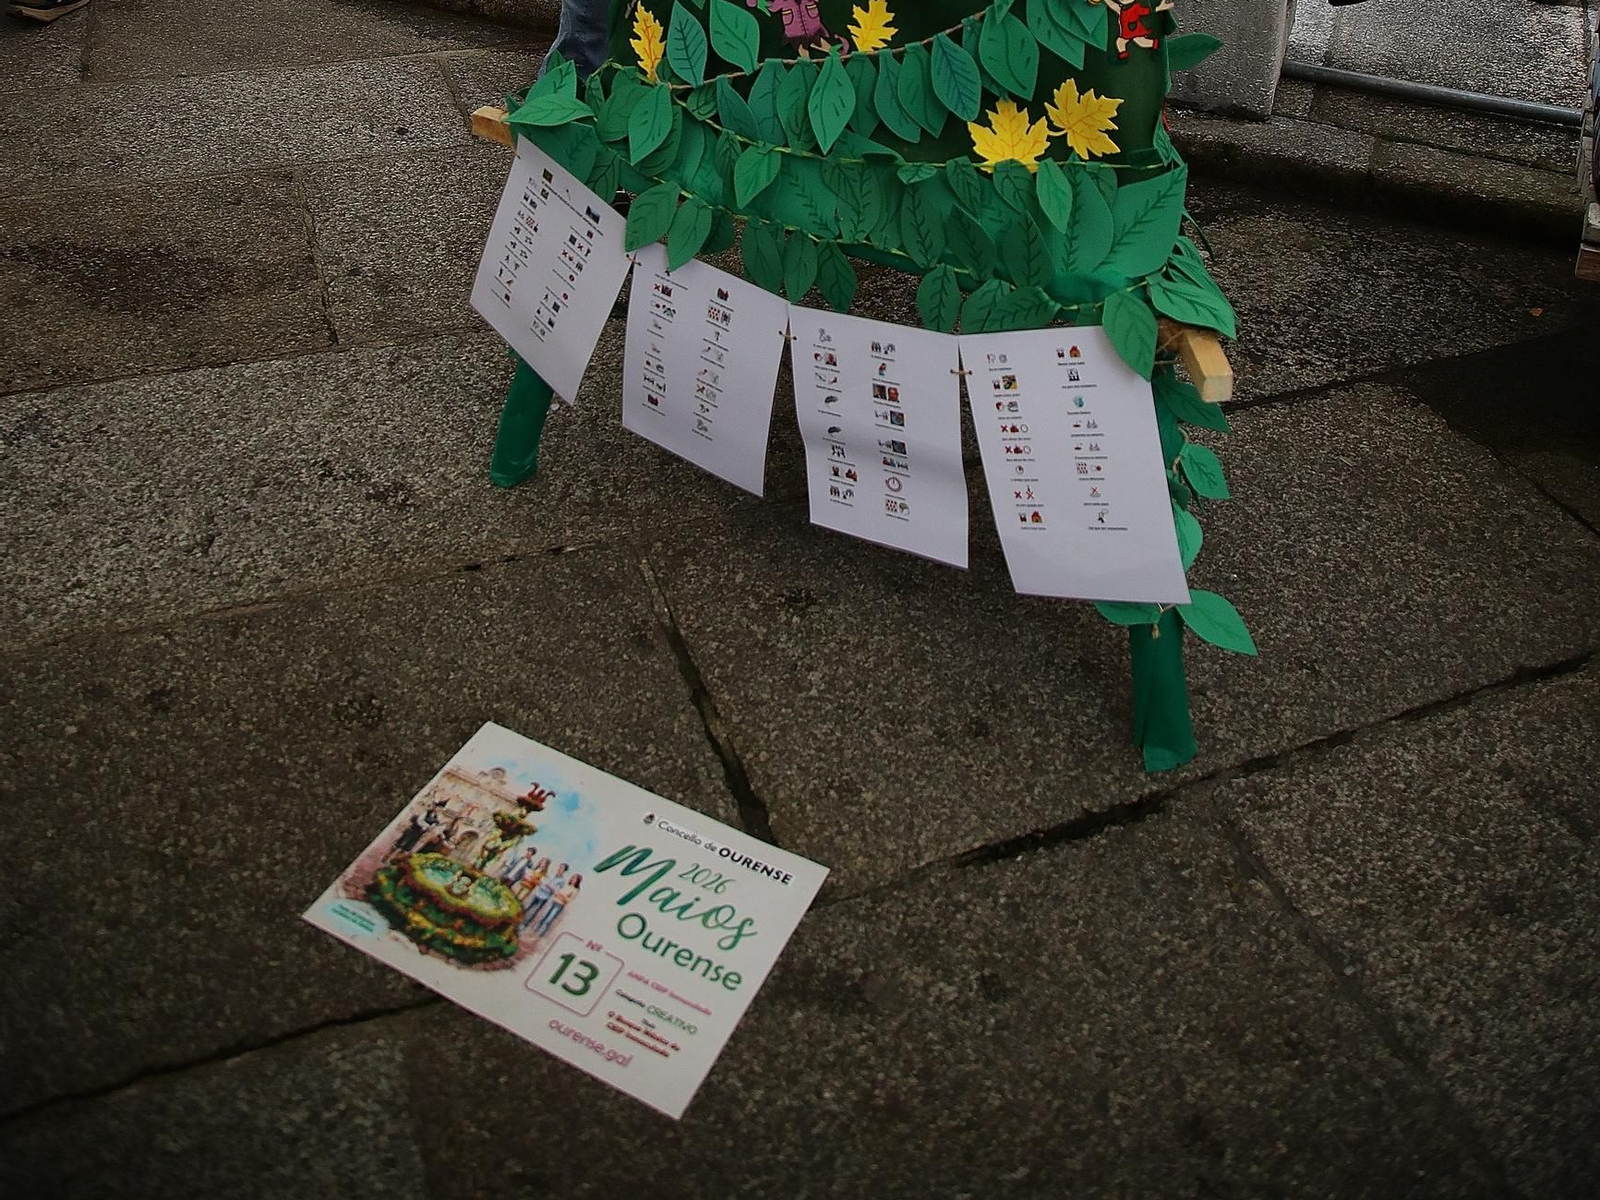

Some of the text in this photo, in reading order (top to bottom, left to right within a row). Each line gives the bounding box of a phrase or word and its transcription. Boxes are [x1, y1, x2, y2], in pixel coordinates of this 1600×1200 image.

[593, 844, 757, 950] Maios
[718, 847, 793, 885] OURENSE
[549, 952, 599, 997] 13
[617, 912, 742, 991] Ourense
